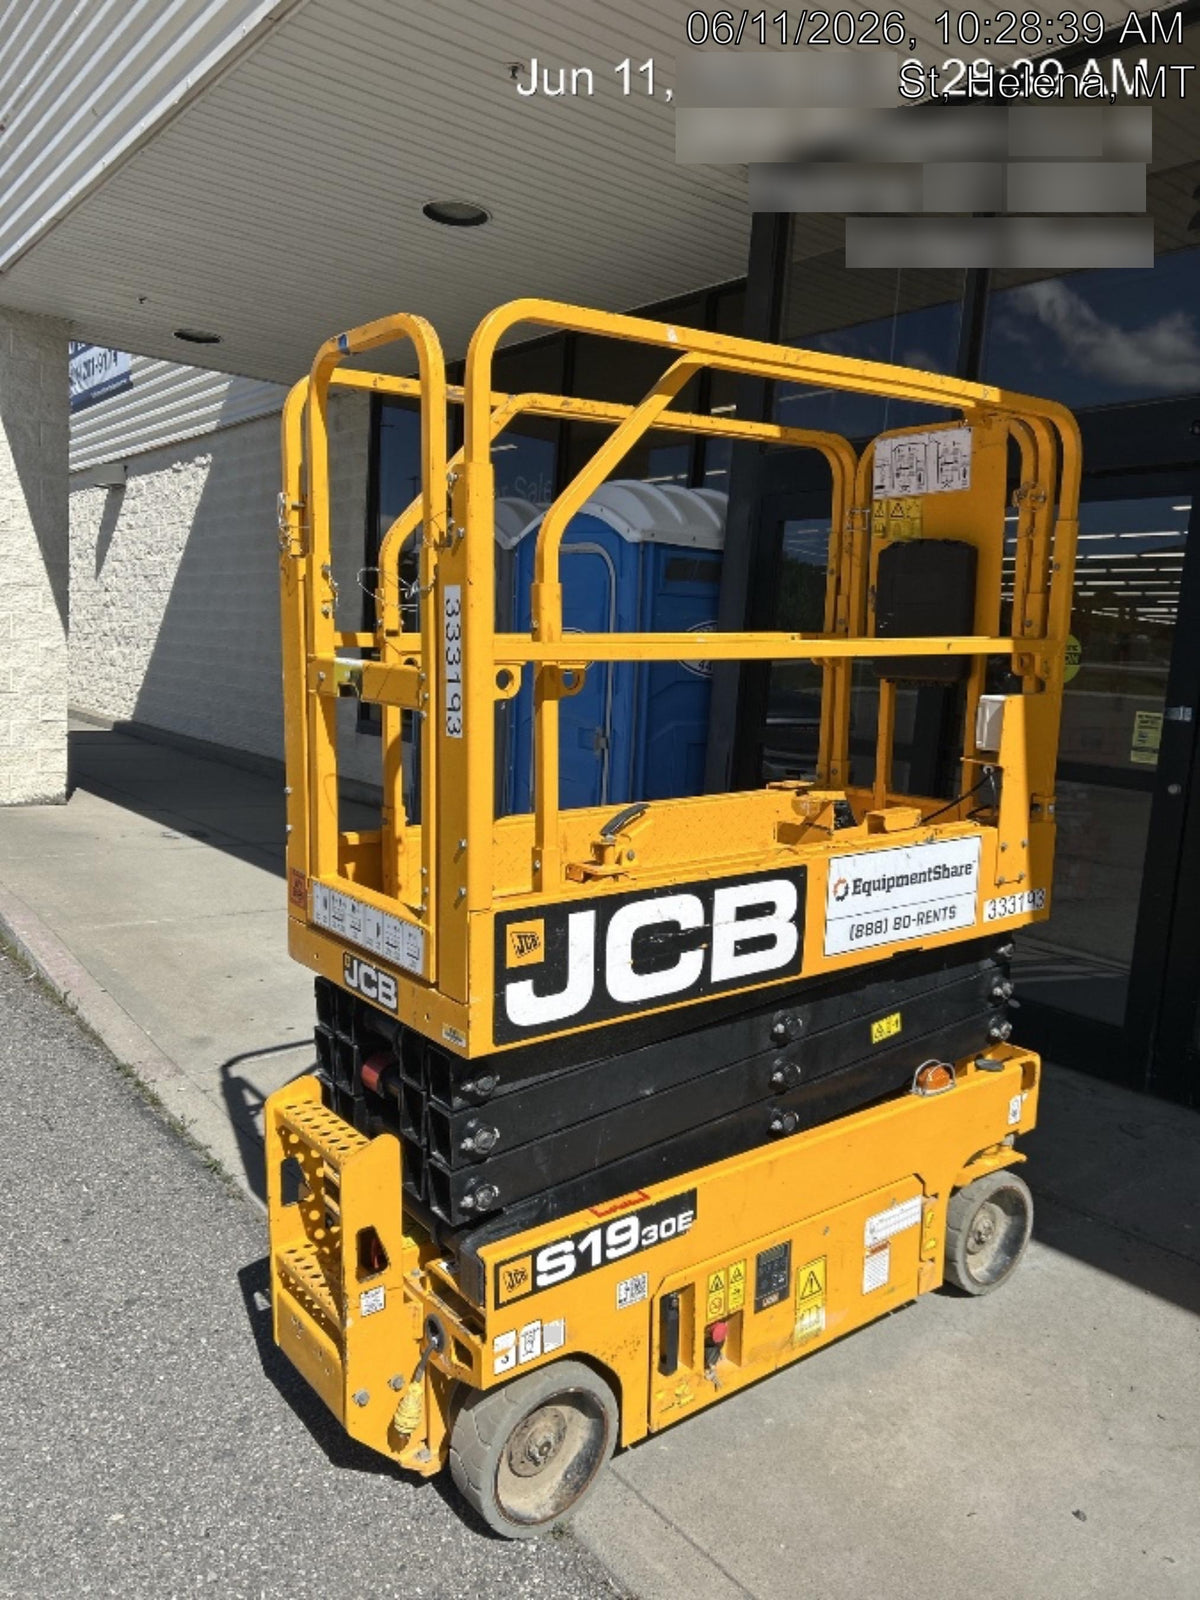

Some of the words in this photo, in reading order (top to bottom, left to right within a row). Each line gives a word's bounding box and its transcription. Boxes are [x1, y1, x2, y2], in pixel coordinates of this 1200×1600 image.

[445, 598, 462, 735] 333193
[851, 863, 972, 897] EquipmentShare
[987, 888, 1046, 920] 333193
[511, 932, 542, 957] JCB
[849, 918, 888, 941] (888)
[505, 879, 798, 1027] JCB
[344, 958, 397, 1010] JCB
